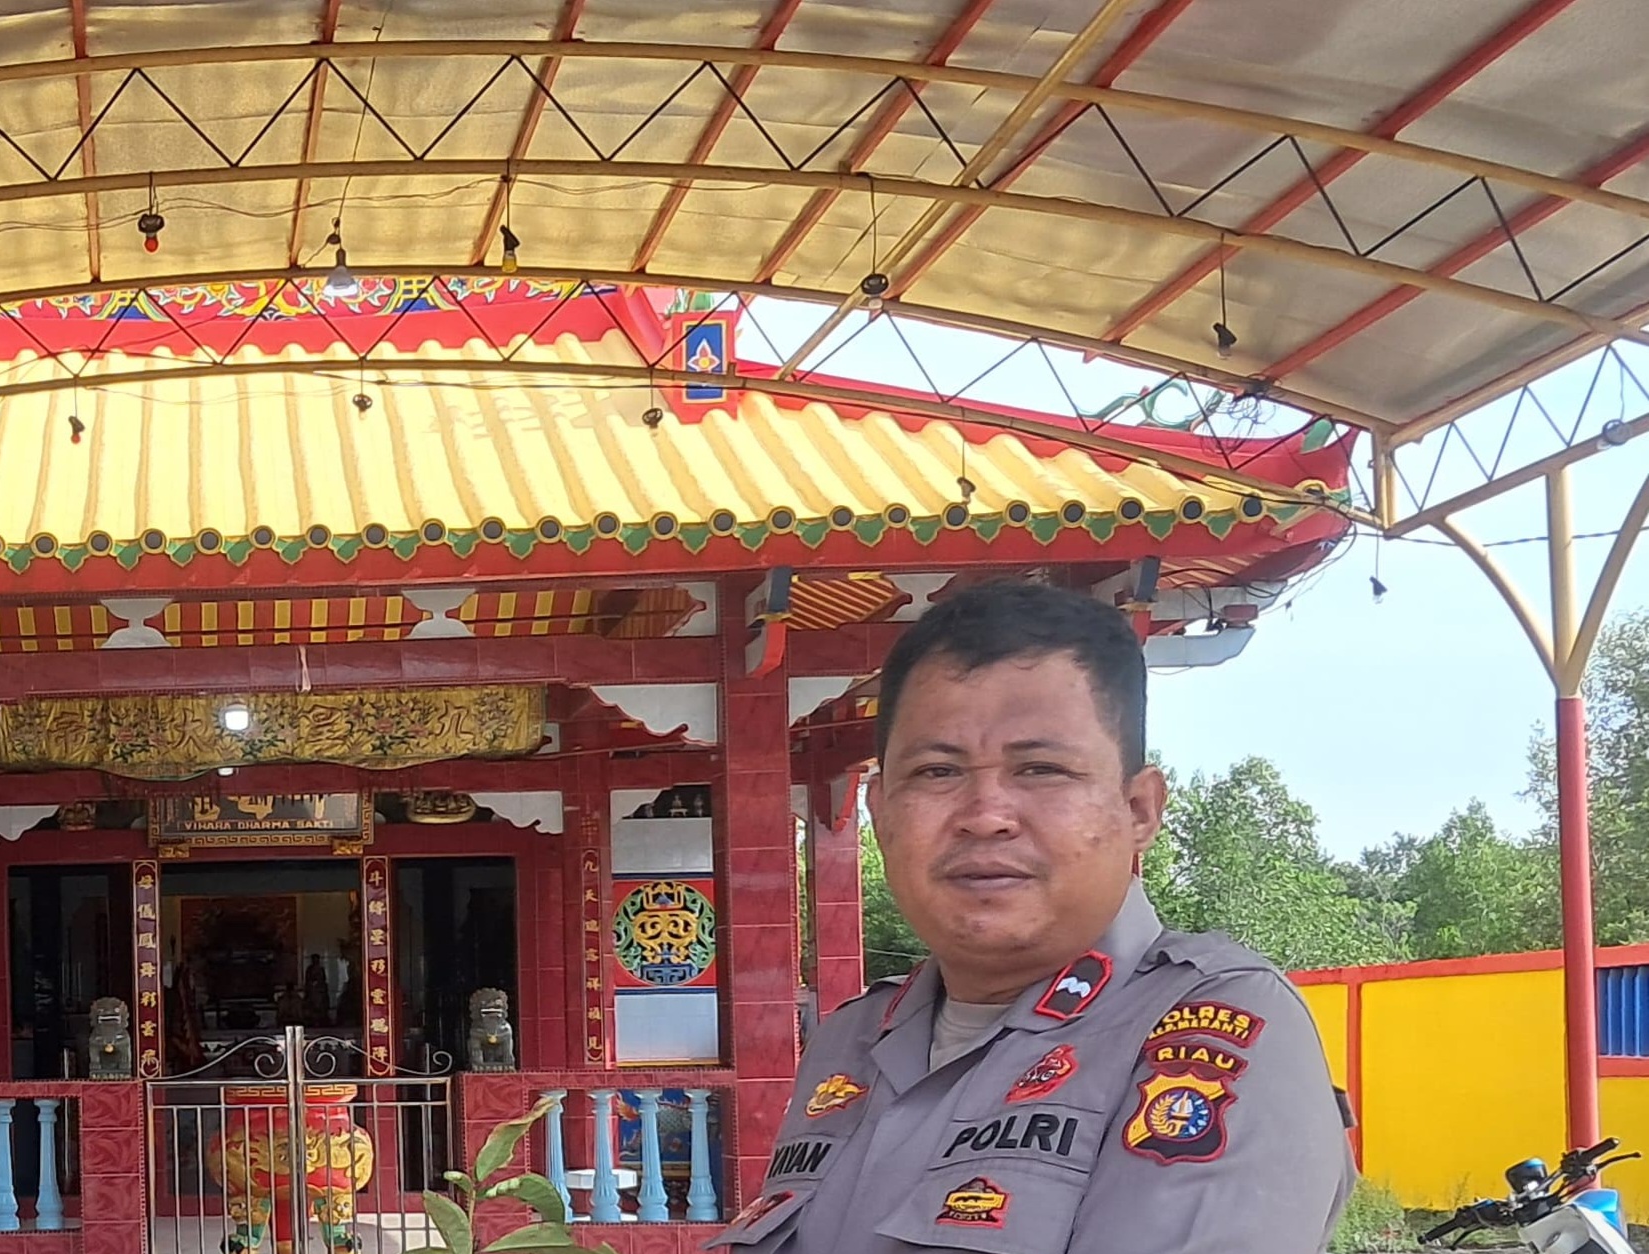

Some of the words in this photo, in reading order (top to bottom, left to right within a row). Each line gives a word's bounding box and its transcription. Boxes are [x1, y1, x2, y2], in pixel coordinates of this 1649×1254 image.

[184, 820, 232, 831] VIHARA
[237, 820, 290, 831] DHARMA
[1162, 1005, 1251, 1030] OLRES
[1157, 1046, 1235, 1070] RIAU
[942, 1113, 1079, 1159] POLRI
